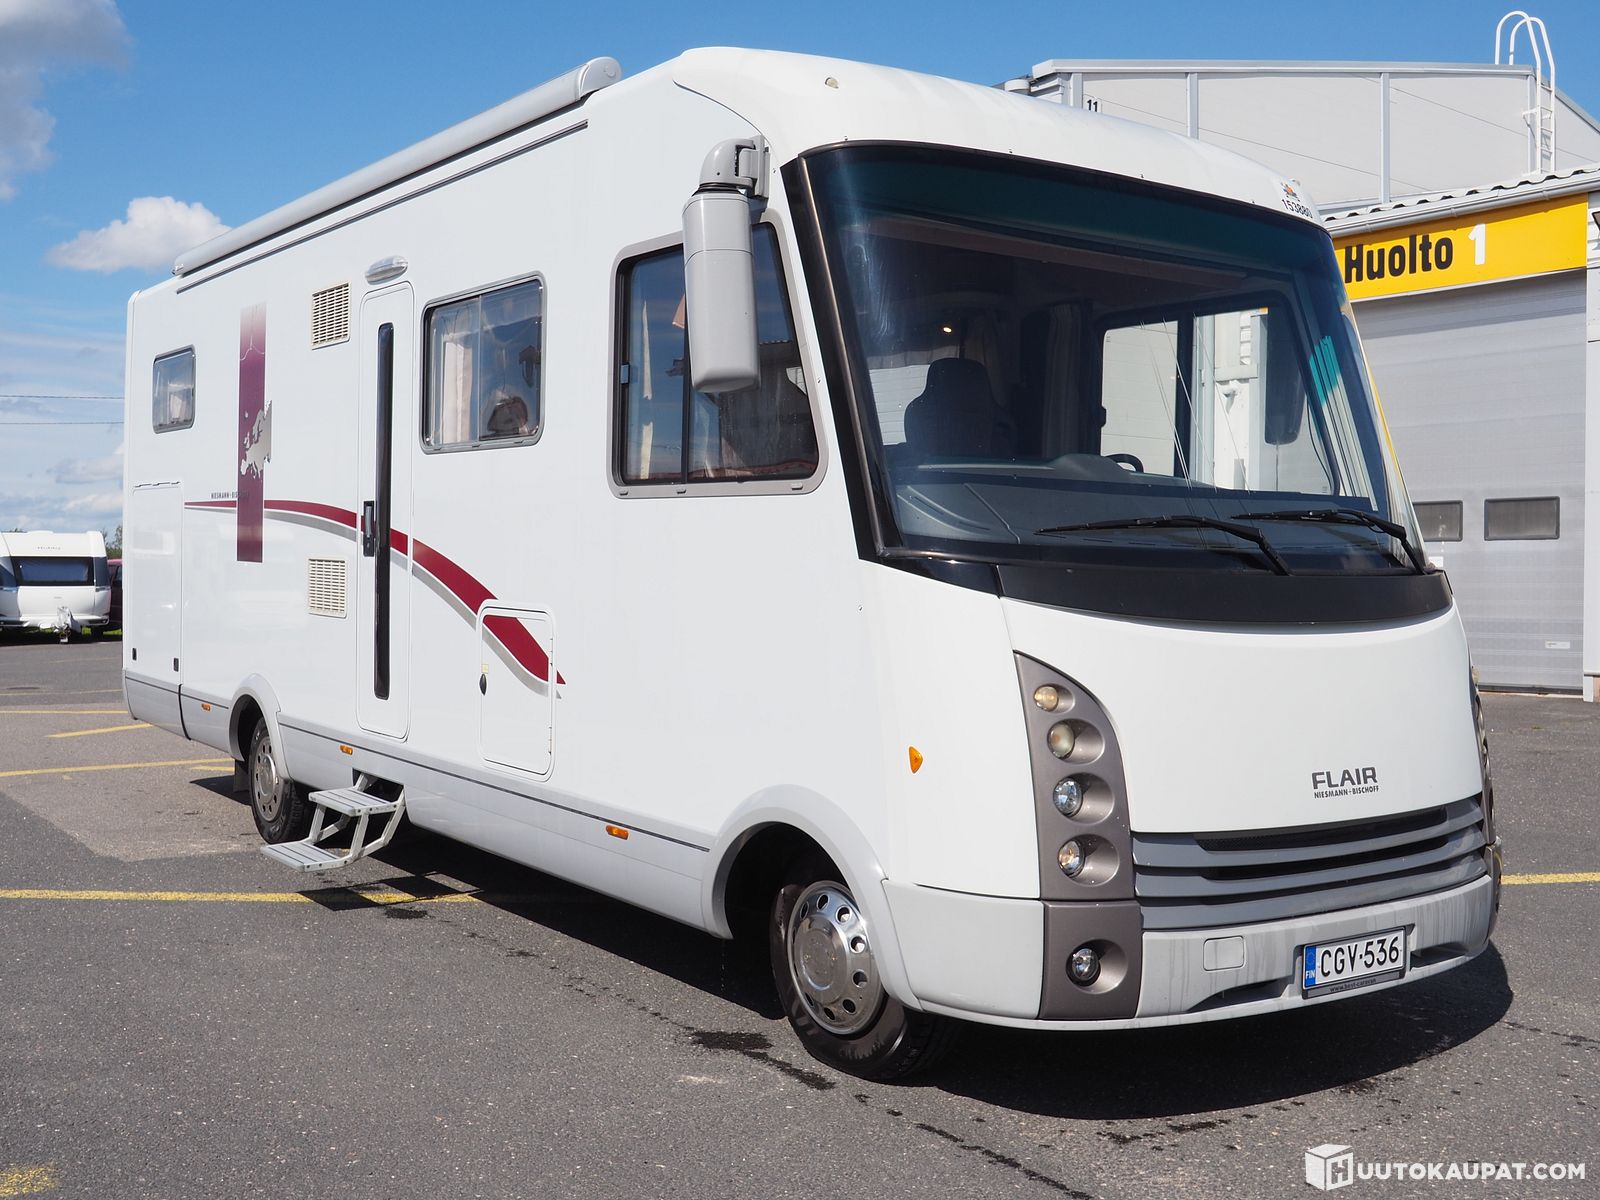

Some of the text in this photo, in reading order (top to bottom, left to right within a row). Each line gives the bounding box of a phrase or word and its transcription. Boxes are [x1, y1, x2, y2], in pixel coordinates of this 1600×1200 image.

[1086, 99, 1098, 112] 11
[1345, 223, 1486, 283] Huolto 1
[1312, 767, 1377, 789] FLAIR
[1321, 936, 1399, 977] CGV-536
[1306, 970, 1315, 979] FIN
